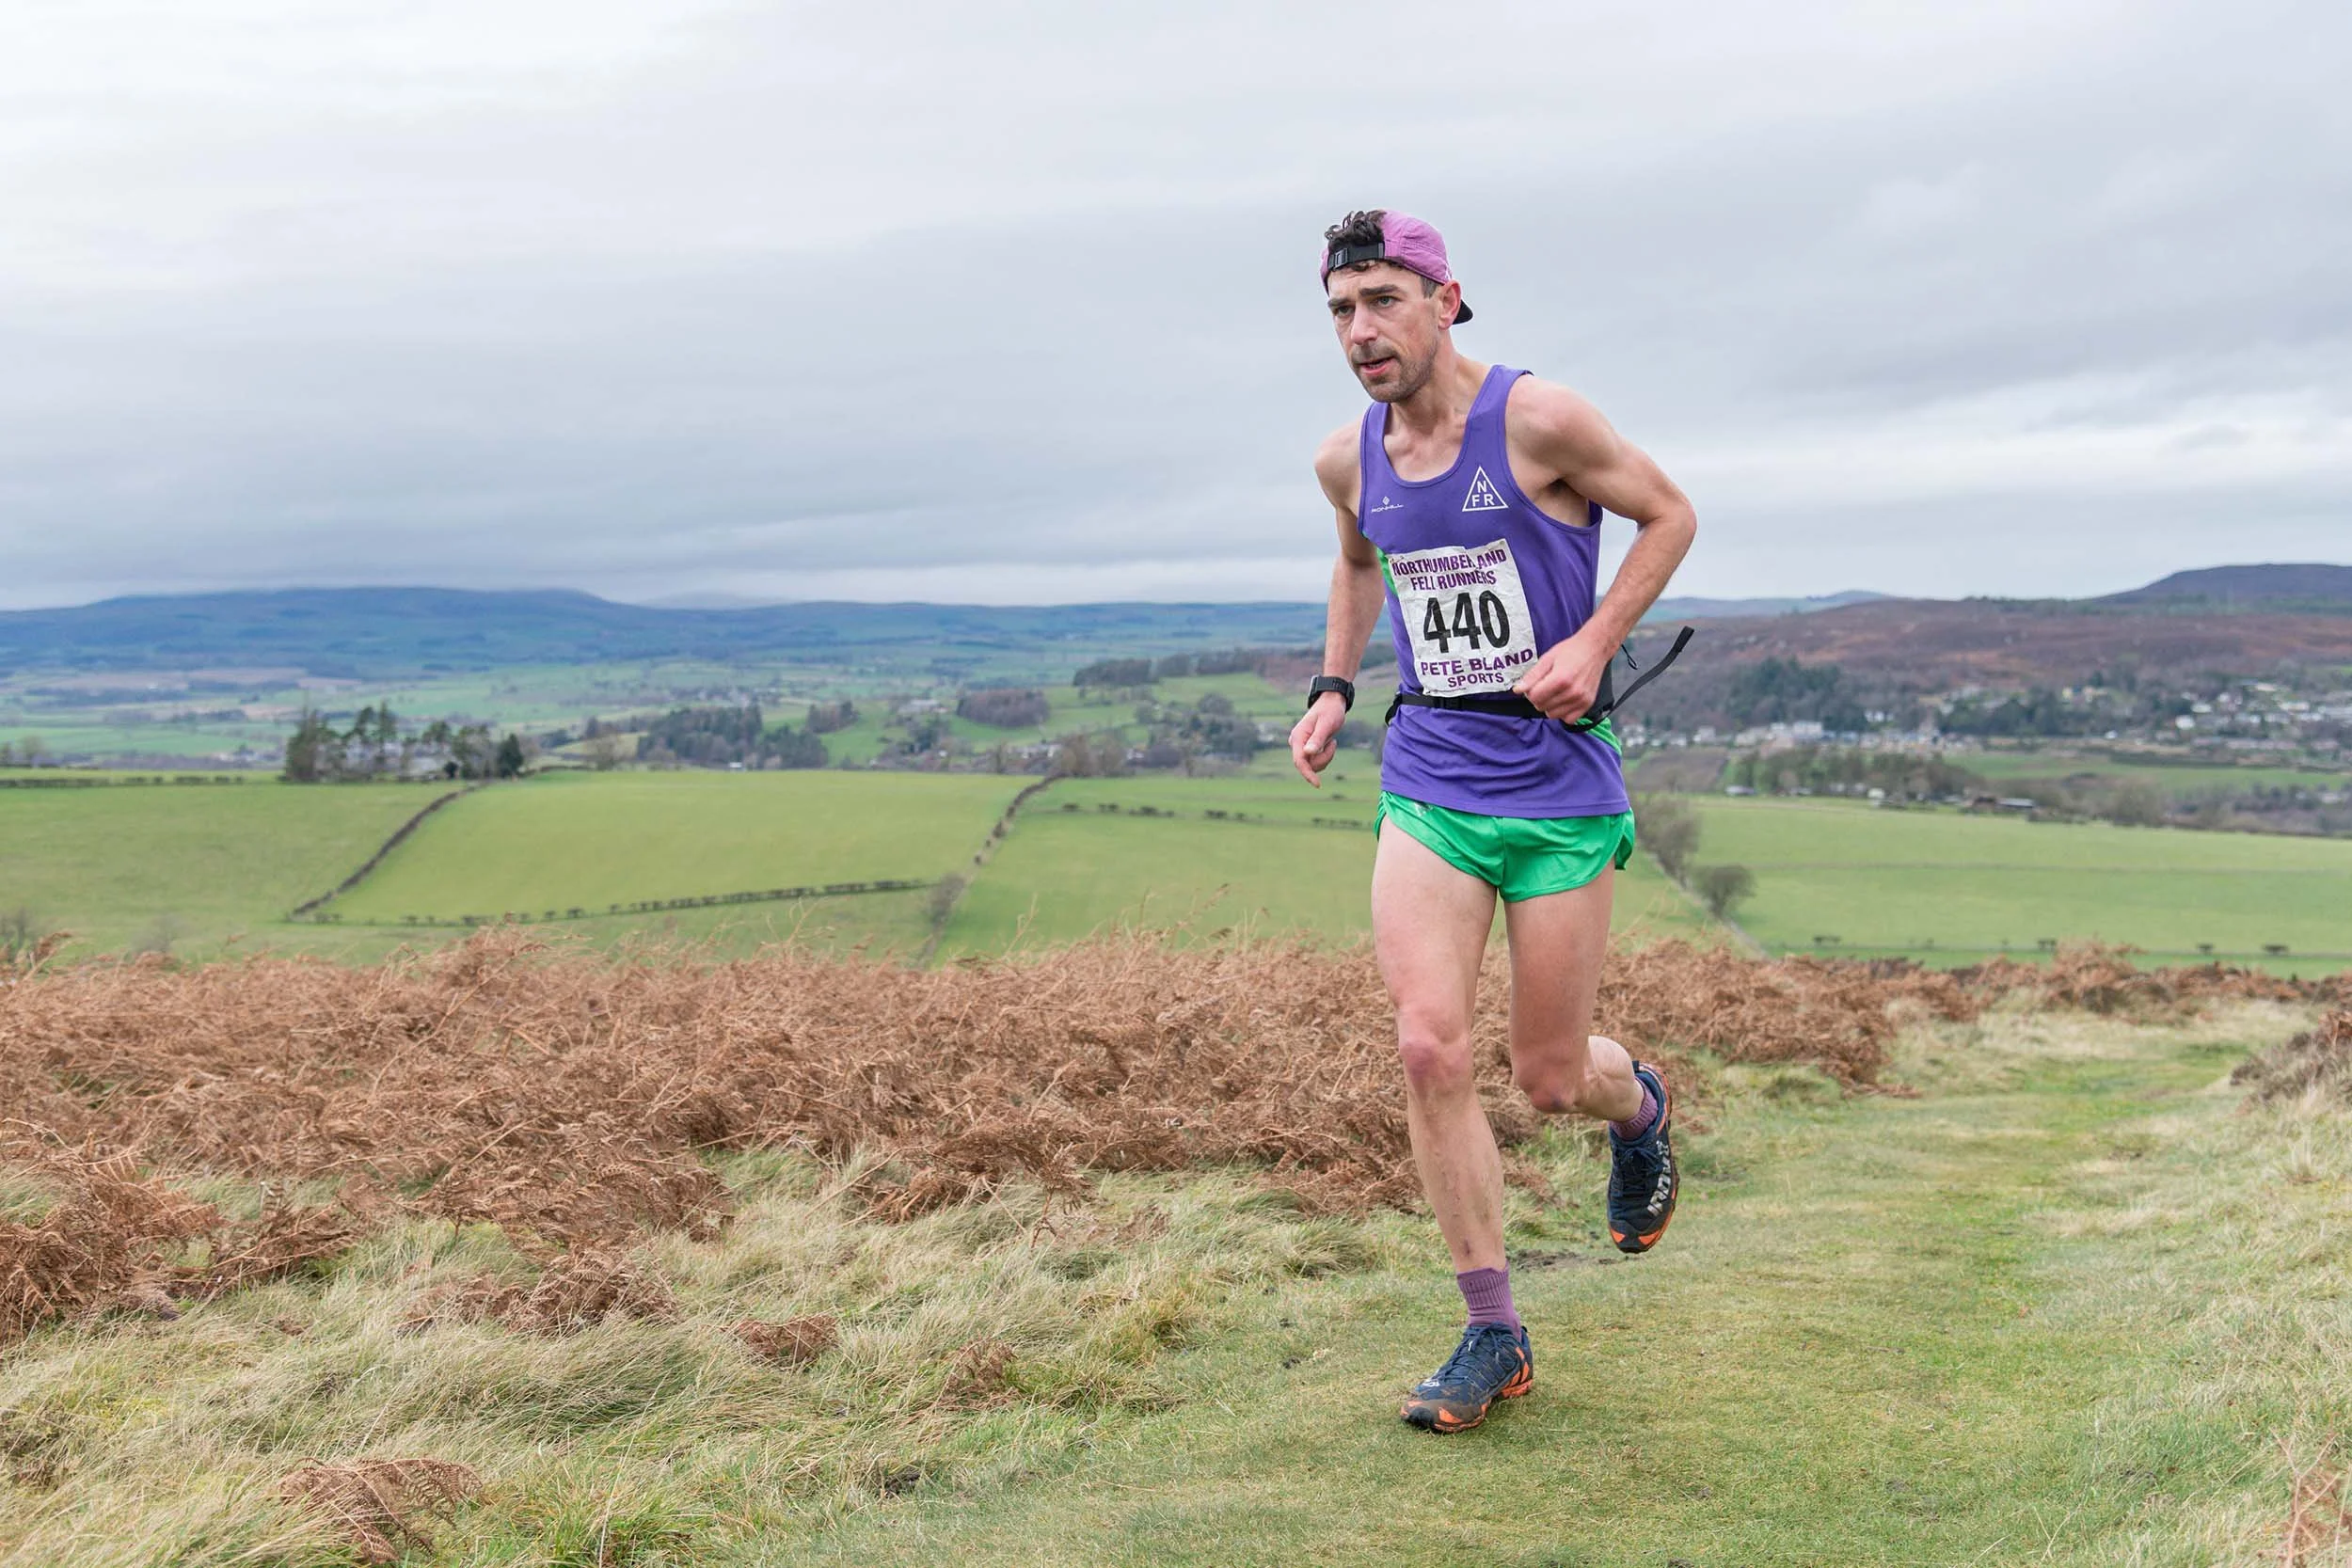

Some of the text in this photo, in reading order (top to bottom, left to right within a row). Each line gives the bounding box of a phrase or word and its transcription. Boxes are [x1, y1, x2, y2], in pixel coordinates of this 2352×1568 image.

[1477, 480, 1487, 493] N
[1391, 548, 1507, 576] NORTHUMBERAND
[1410, 570, 1497, 591] FELL RUNNERS
[1423, 590, 1510, 654] 440
[1421, 648, 1534, 676] PETE BLAND
[1448, 672, 1504, 689] SPORTS
